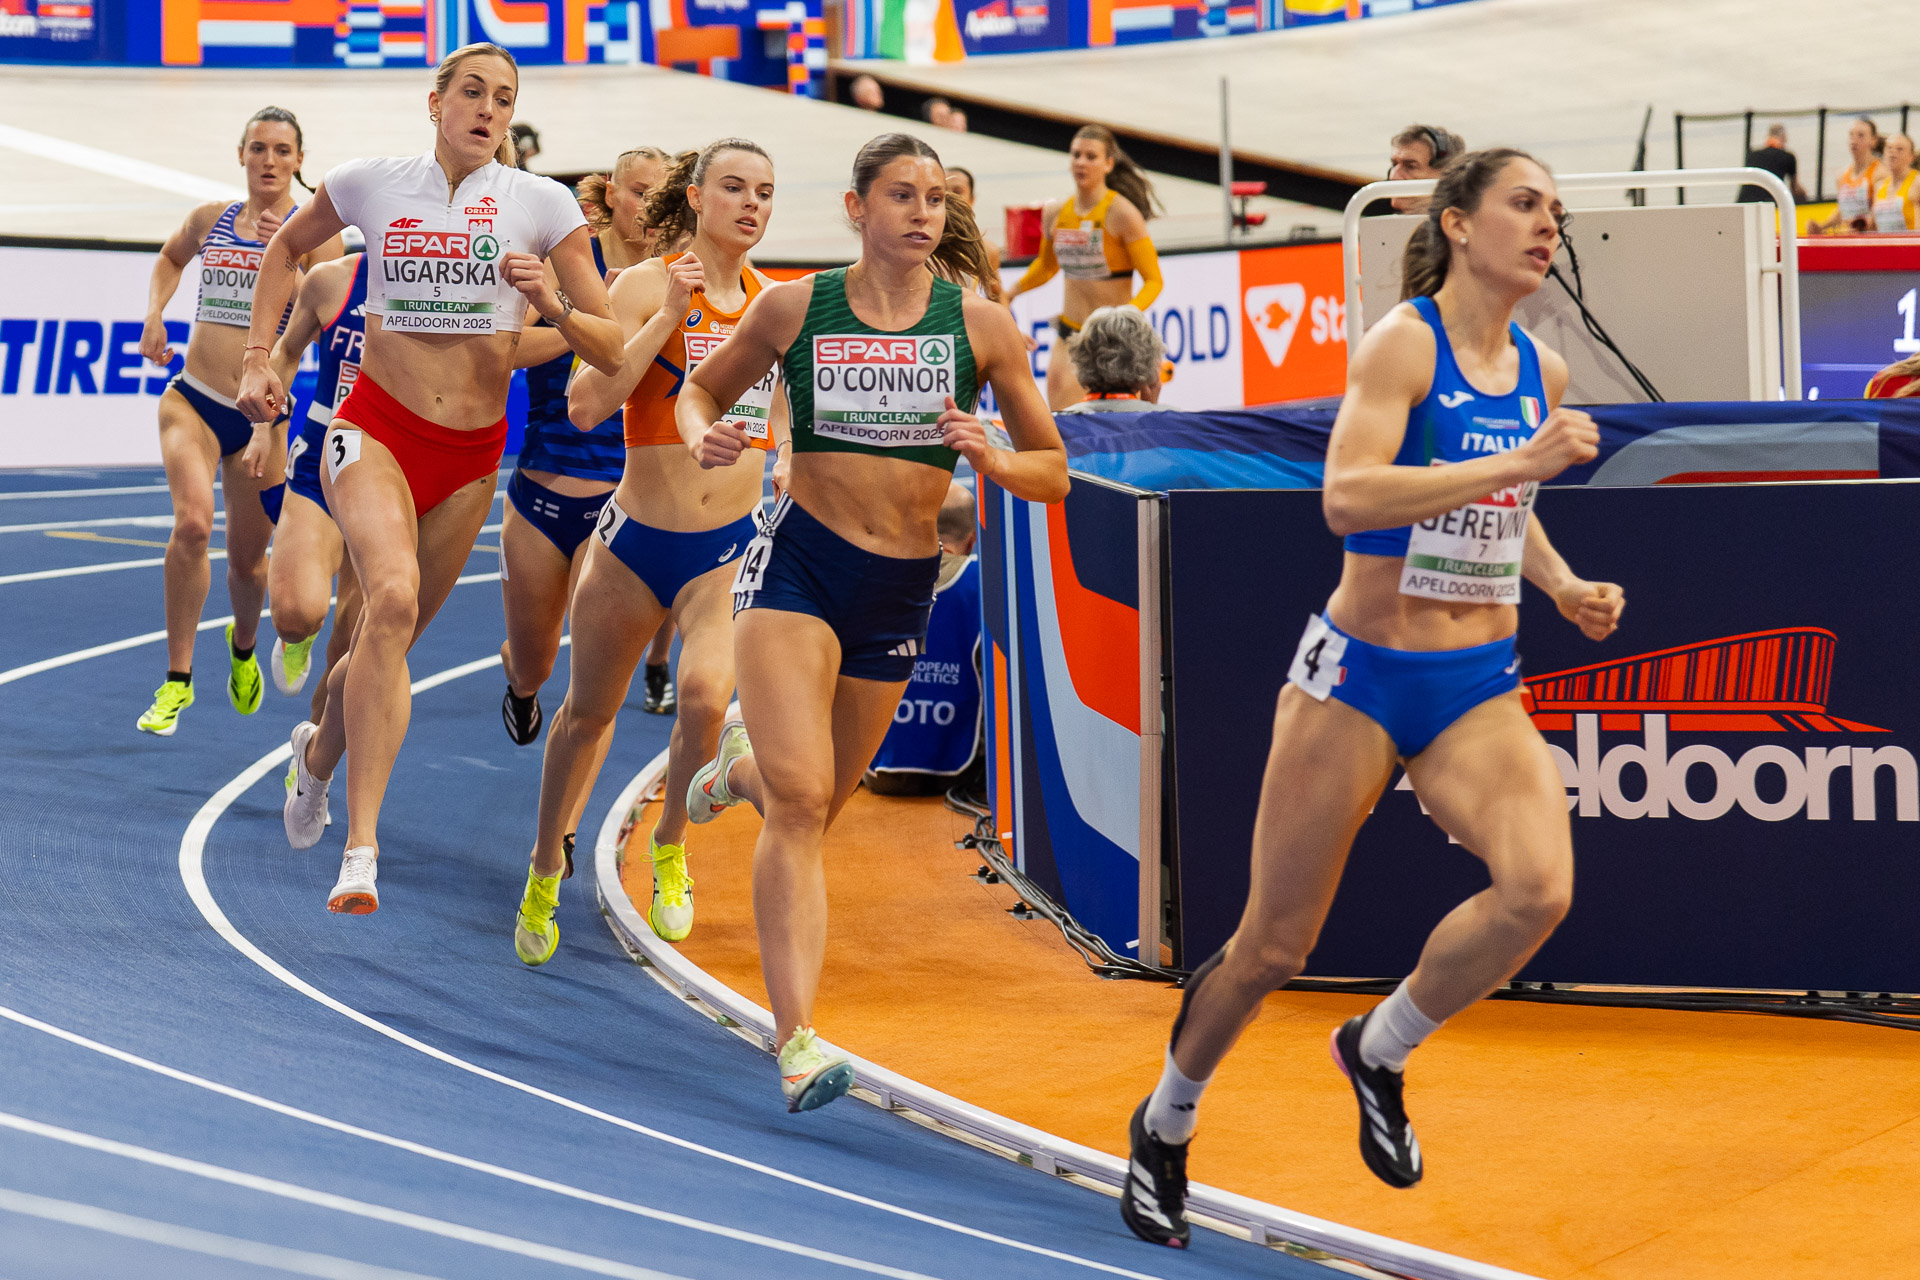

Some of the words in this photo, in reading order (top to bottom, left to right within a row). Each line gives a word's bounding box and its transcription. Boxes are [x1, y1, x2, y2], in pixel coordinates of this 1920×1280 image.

[389, 217, 424, 229] 4F
[385, 235, 467, 255] SPAR
[205, 251, 261, 269] SPAR
[383, 260, 496, 286] LIGARSKA
[232, 289, 239, 298] 3
[433, 286, 441, 297] 5
[214, 299, 230, 307] RUN
[408, 302, 430, 311] RUN
[202, 310, 251, 322] APELDOORN
[386, 316, 460, 328] APELDOORN
[463, 318, 492, 329] 2025
[0, 320, 190, 395] TIRES
[819, 341, 914, 361] SPAR
[817, 365, 950, 393] O'CONNOR
[879, 395, 888, 407] 4
[849, 413, 878, 423] RUN
[752, 423, 766, 433] 2025
[820, 423, 910, 441] APELDOORN
[913, 428, 945, 440] 2025
[332, 434, 346, 467] 3
[1478, 544, 1488, 558] 7
[739, 546, 765, 583] 14
[1443, 560, 1473, 574] RUN
[1406, 575, 1495, 597] APELDOORN
[1495, 583, 1516, 596] 2025
[1304, 637, 1327, 681] 4
